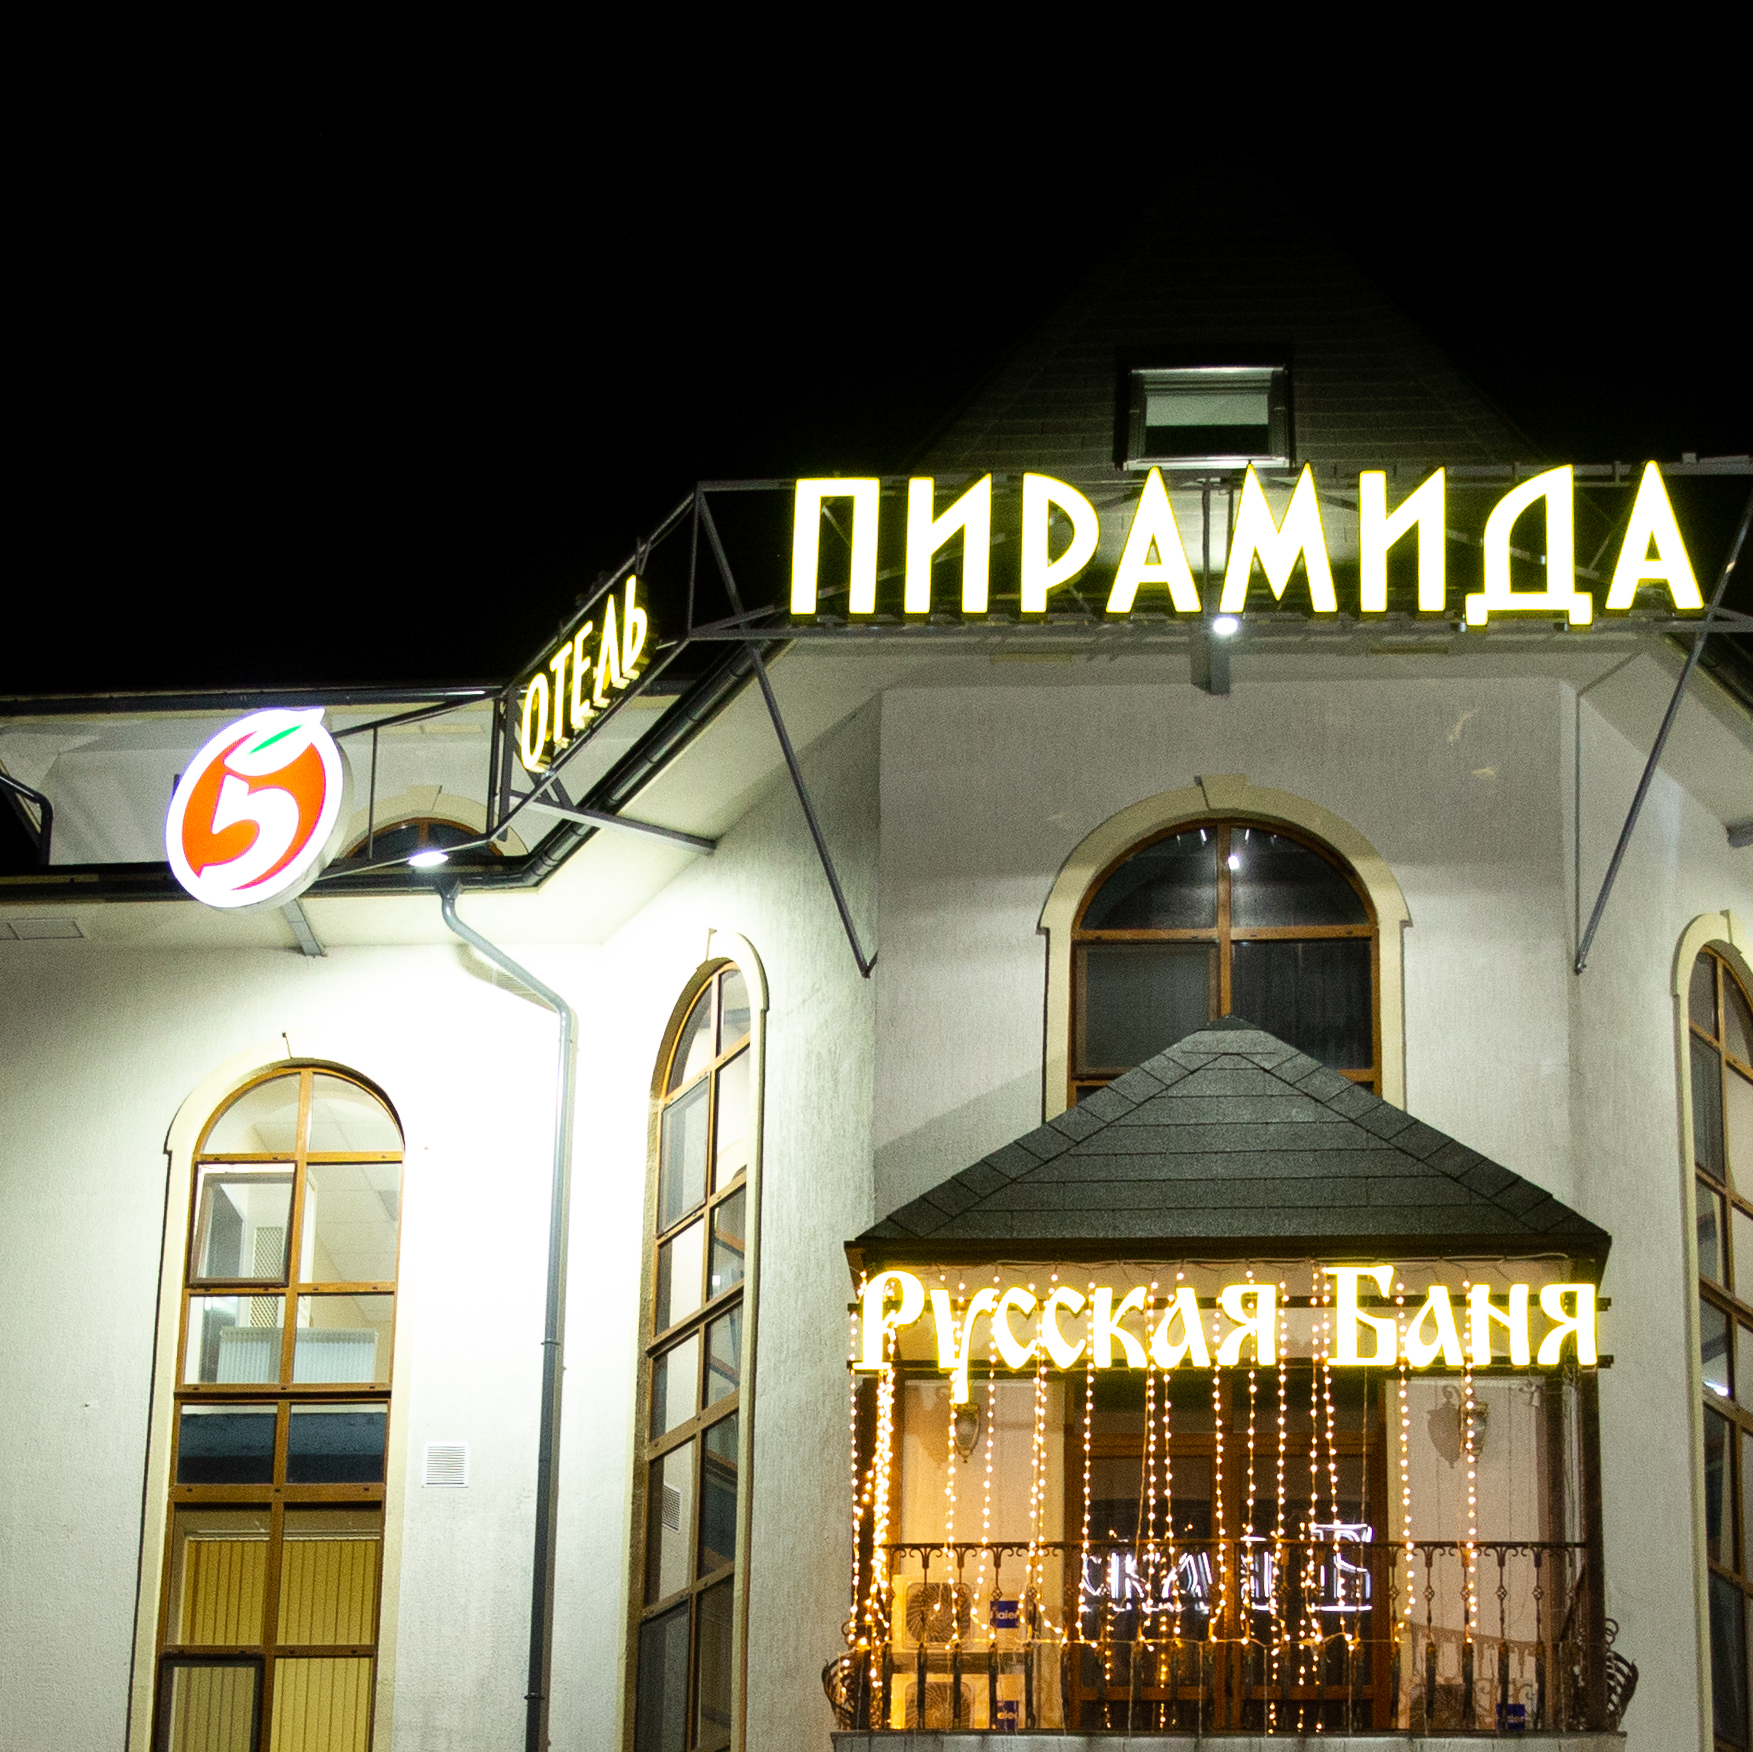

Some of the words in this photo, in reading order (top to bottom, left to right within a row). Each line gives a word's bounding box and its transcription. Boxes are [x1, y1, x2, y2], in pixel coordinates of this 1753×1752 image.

[789, 458, 1706, 628] ПИРАМИДА
[520, 574, 648, 774] ОТЕЛЬ
[851, 1267, 1277, 1404] Русская
[1324, 1264, 1599, 1367] Баня
